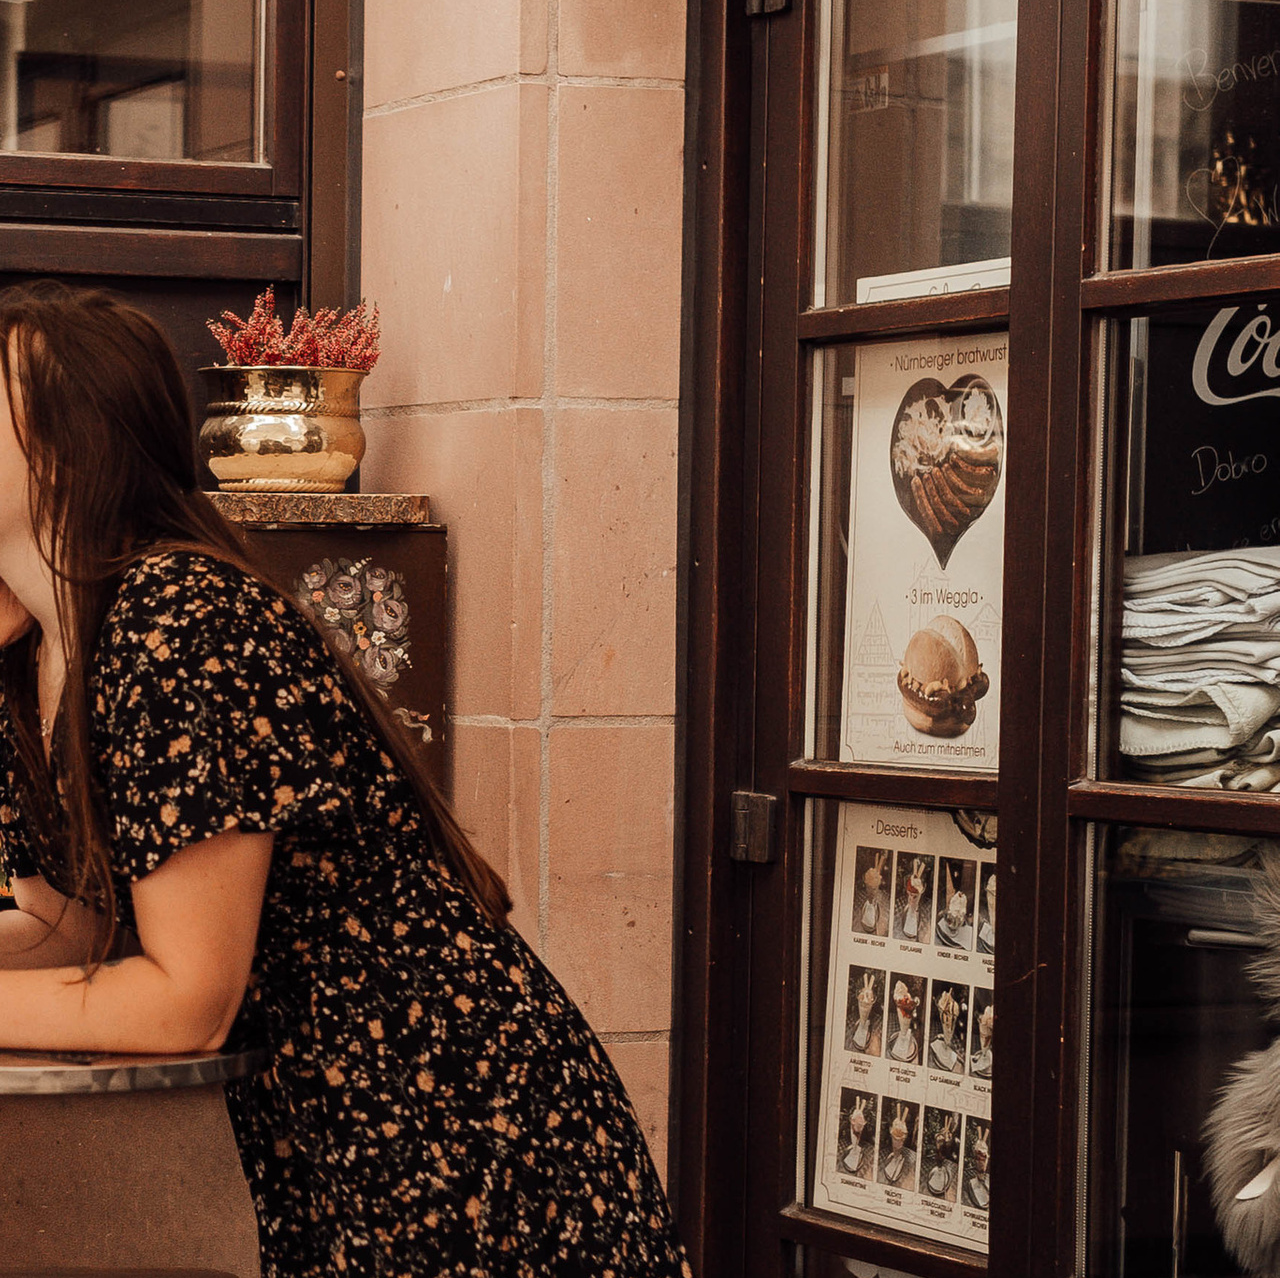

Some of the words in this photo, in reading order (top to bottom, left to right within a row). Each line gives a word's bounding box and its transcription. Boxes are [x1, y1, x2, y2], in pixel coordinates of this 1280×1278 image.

[894, 352, 955, 372] Nürnberger
[956, 343, 1007, 365] bratwurst
[1191, 445, 1268, 495] Dobro
[910, 588, 918, 604] 3
[920, 589, 933, 604] im
[936, 588, 978, 608] Weggla
[893, 740, 916, 754] Auch
[917, 744, 935, 755] zum
[937, 744, 986, 758] mitnehmen
[876, 819, 918, 839] Desserts
